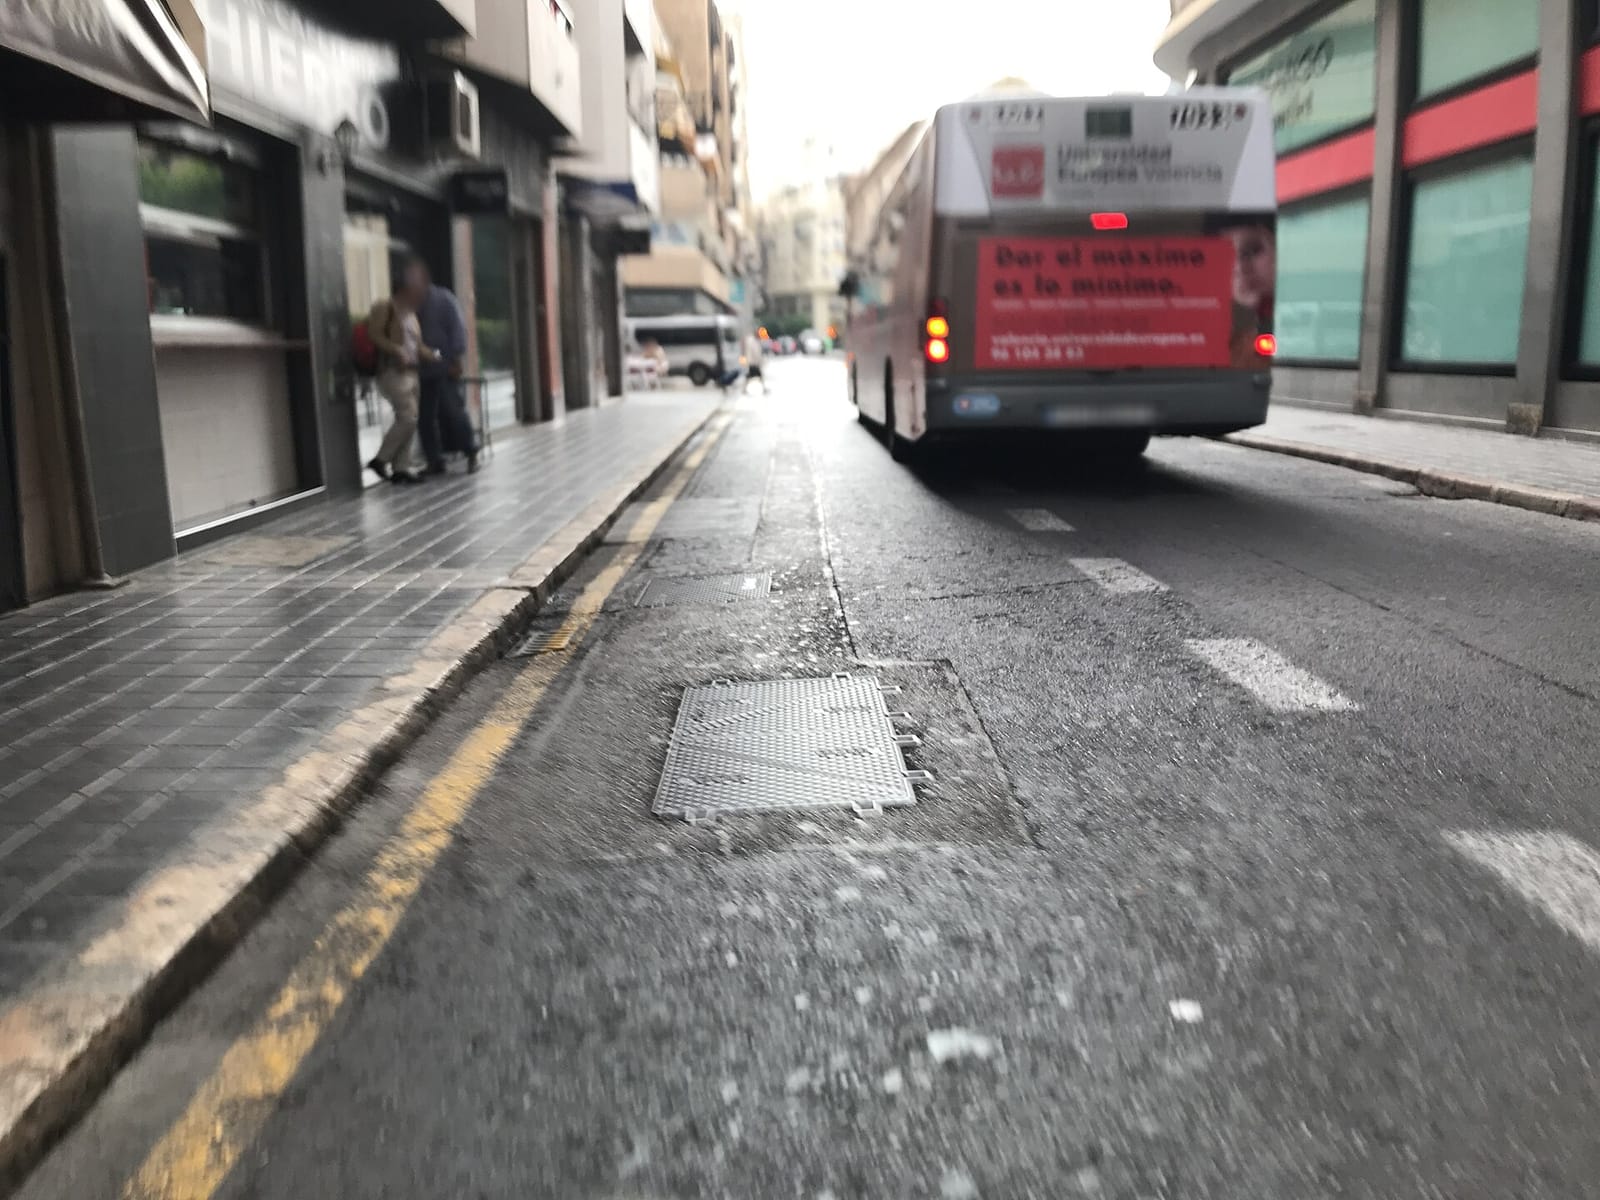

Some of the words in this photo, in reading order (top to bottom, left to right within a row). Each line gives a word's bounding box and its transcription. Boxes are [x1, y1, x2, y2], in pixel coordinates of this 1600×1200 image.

[995, 244, 1043, 267] Dar
[1055, 245, 1082, 267] el
[993, 277, 1022, 297] es
[1034, 273, 1060, 296] lo
